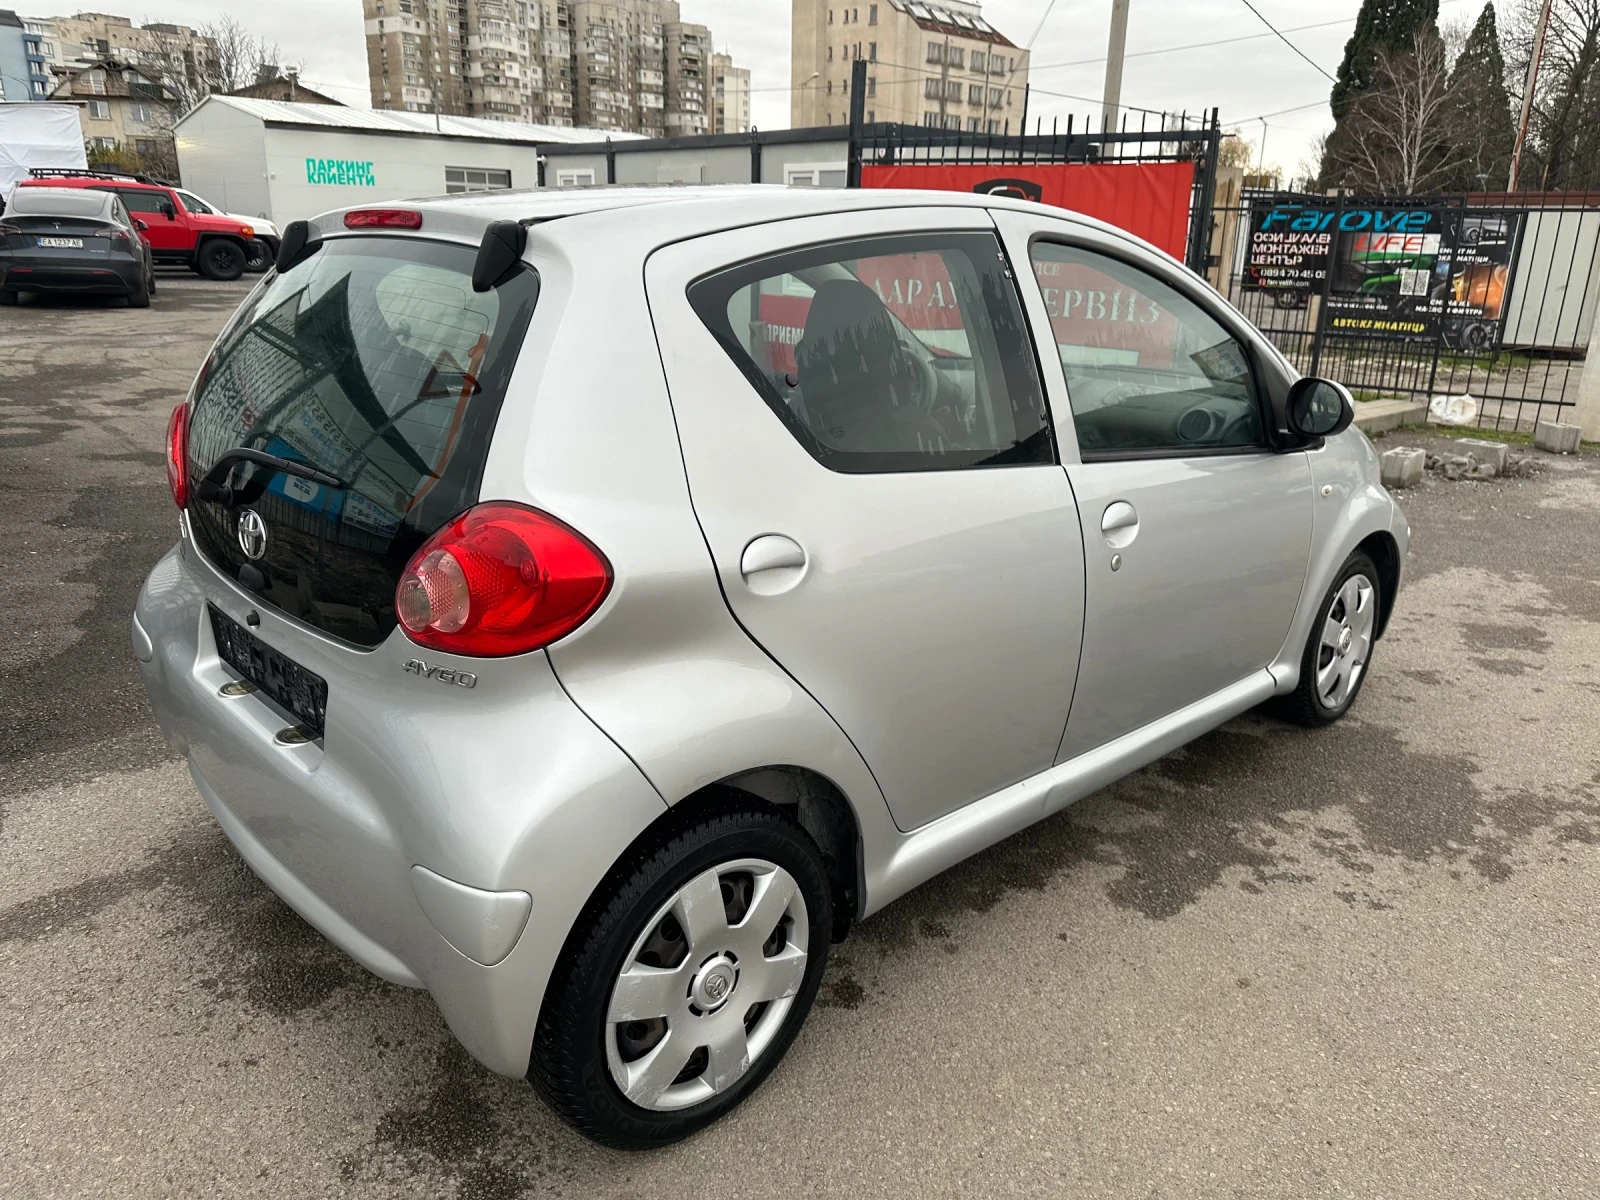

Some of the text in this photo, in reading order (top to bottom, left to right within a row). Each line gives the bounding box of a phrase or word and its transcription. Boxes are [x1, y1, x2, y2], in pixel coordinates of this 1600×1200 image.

[305, 158, 374, 175] ПАРКИНГ
[307, 171, 375, 187] КЛИЕНТИ
[1260, 204, 1433, 232] Farove
[1252, 243, 1329, 256] МОНТАЖЕН
[1353, 235, 1428, 252] LIFE
[1251, 254, 1303, 266] ЦЕНТЪР
[402, 658, 478, 689] AYGO
